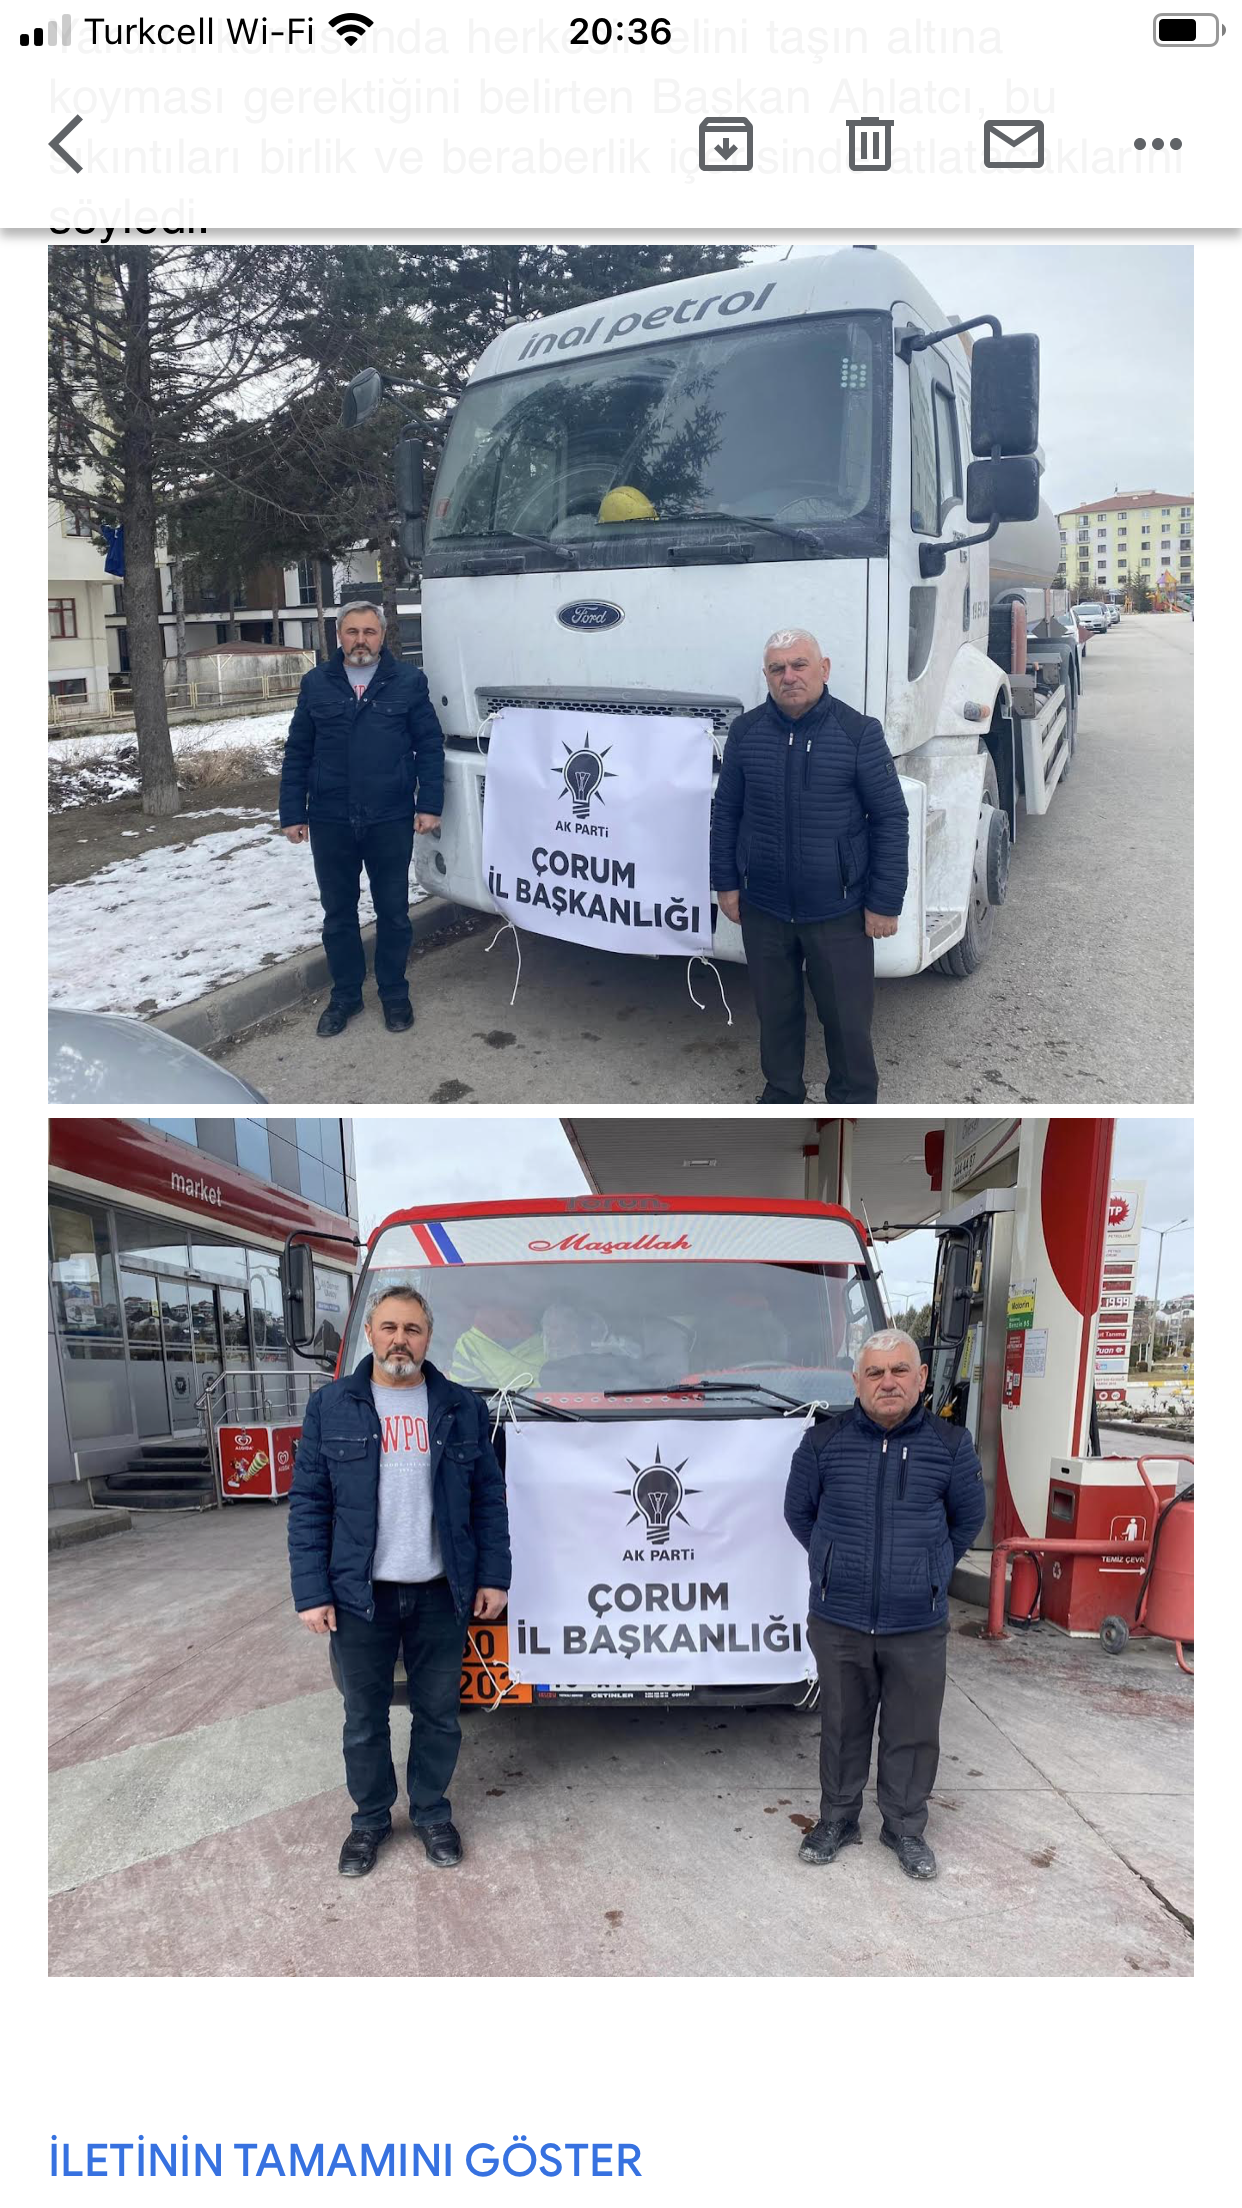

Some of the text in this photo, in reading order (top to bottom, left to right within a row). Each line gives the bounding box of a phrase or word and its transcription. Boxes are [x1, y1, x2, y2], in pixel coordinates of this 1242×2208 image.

[604, 282, 777, 344] petrol
[571, 606, 608, 624] Ford
[555, 820, 572, 833] AK
[531, 846, 636, 889] ÇORUM
[488, 865, 700, 933] İL BAŞKANLIĞI
[171, 1171, 222, 1207] market
[1108, 1206, 1123, 1216] TP
[528, 1233, 693, 1255] Maşallah
[379, 1415, 429, 1453] WPO
[622, 1549, 644, 1562] AK
[587, 1582, 729, 1619] ÇORUM
[517, 1614, 802, 1660] İL BAŞKANLIĞI
